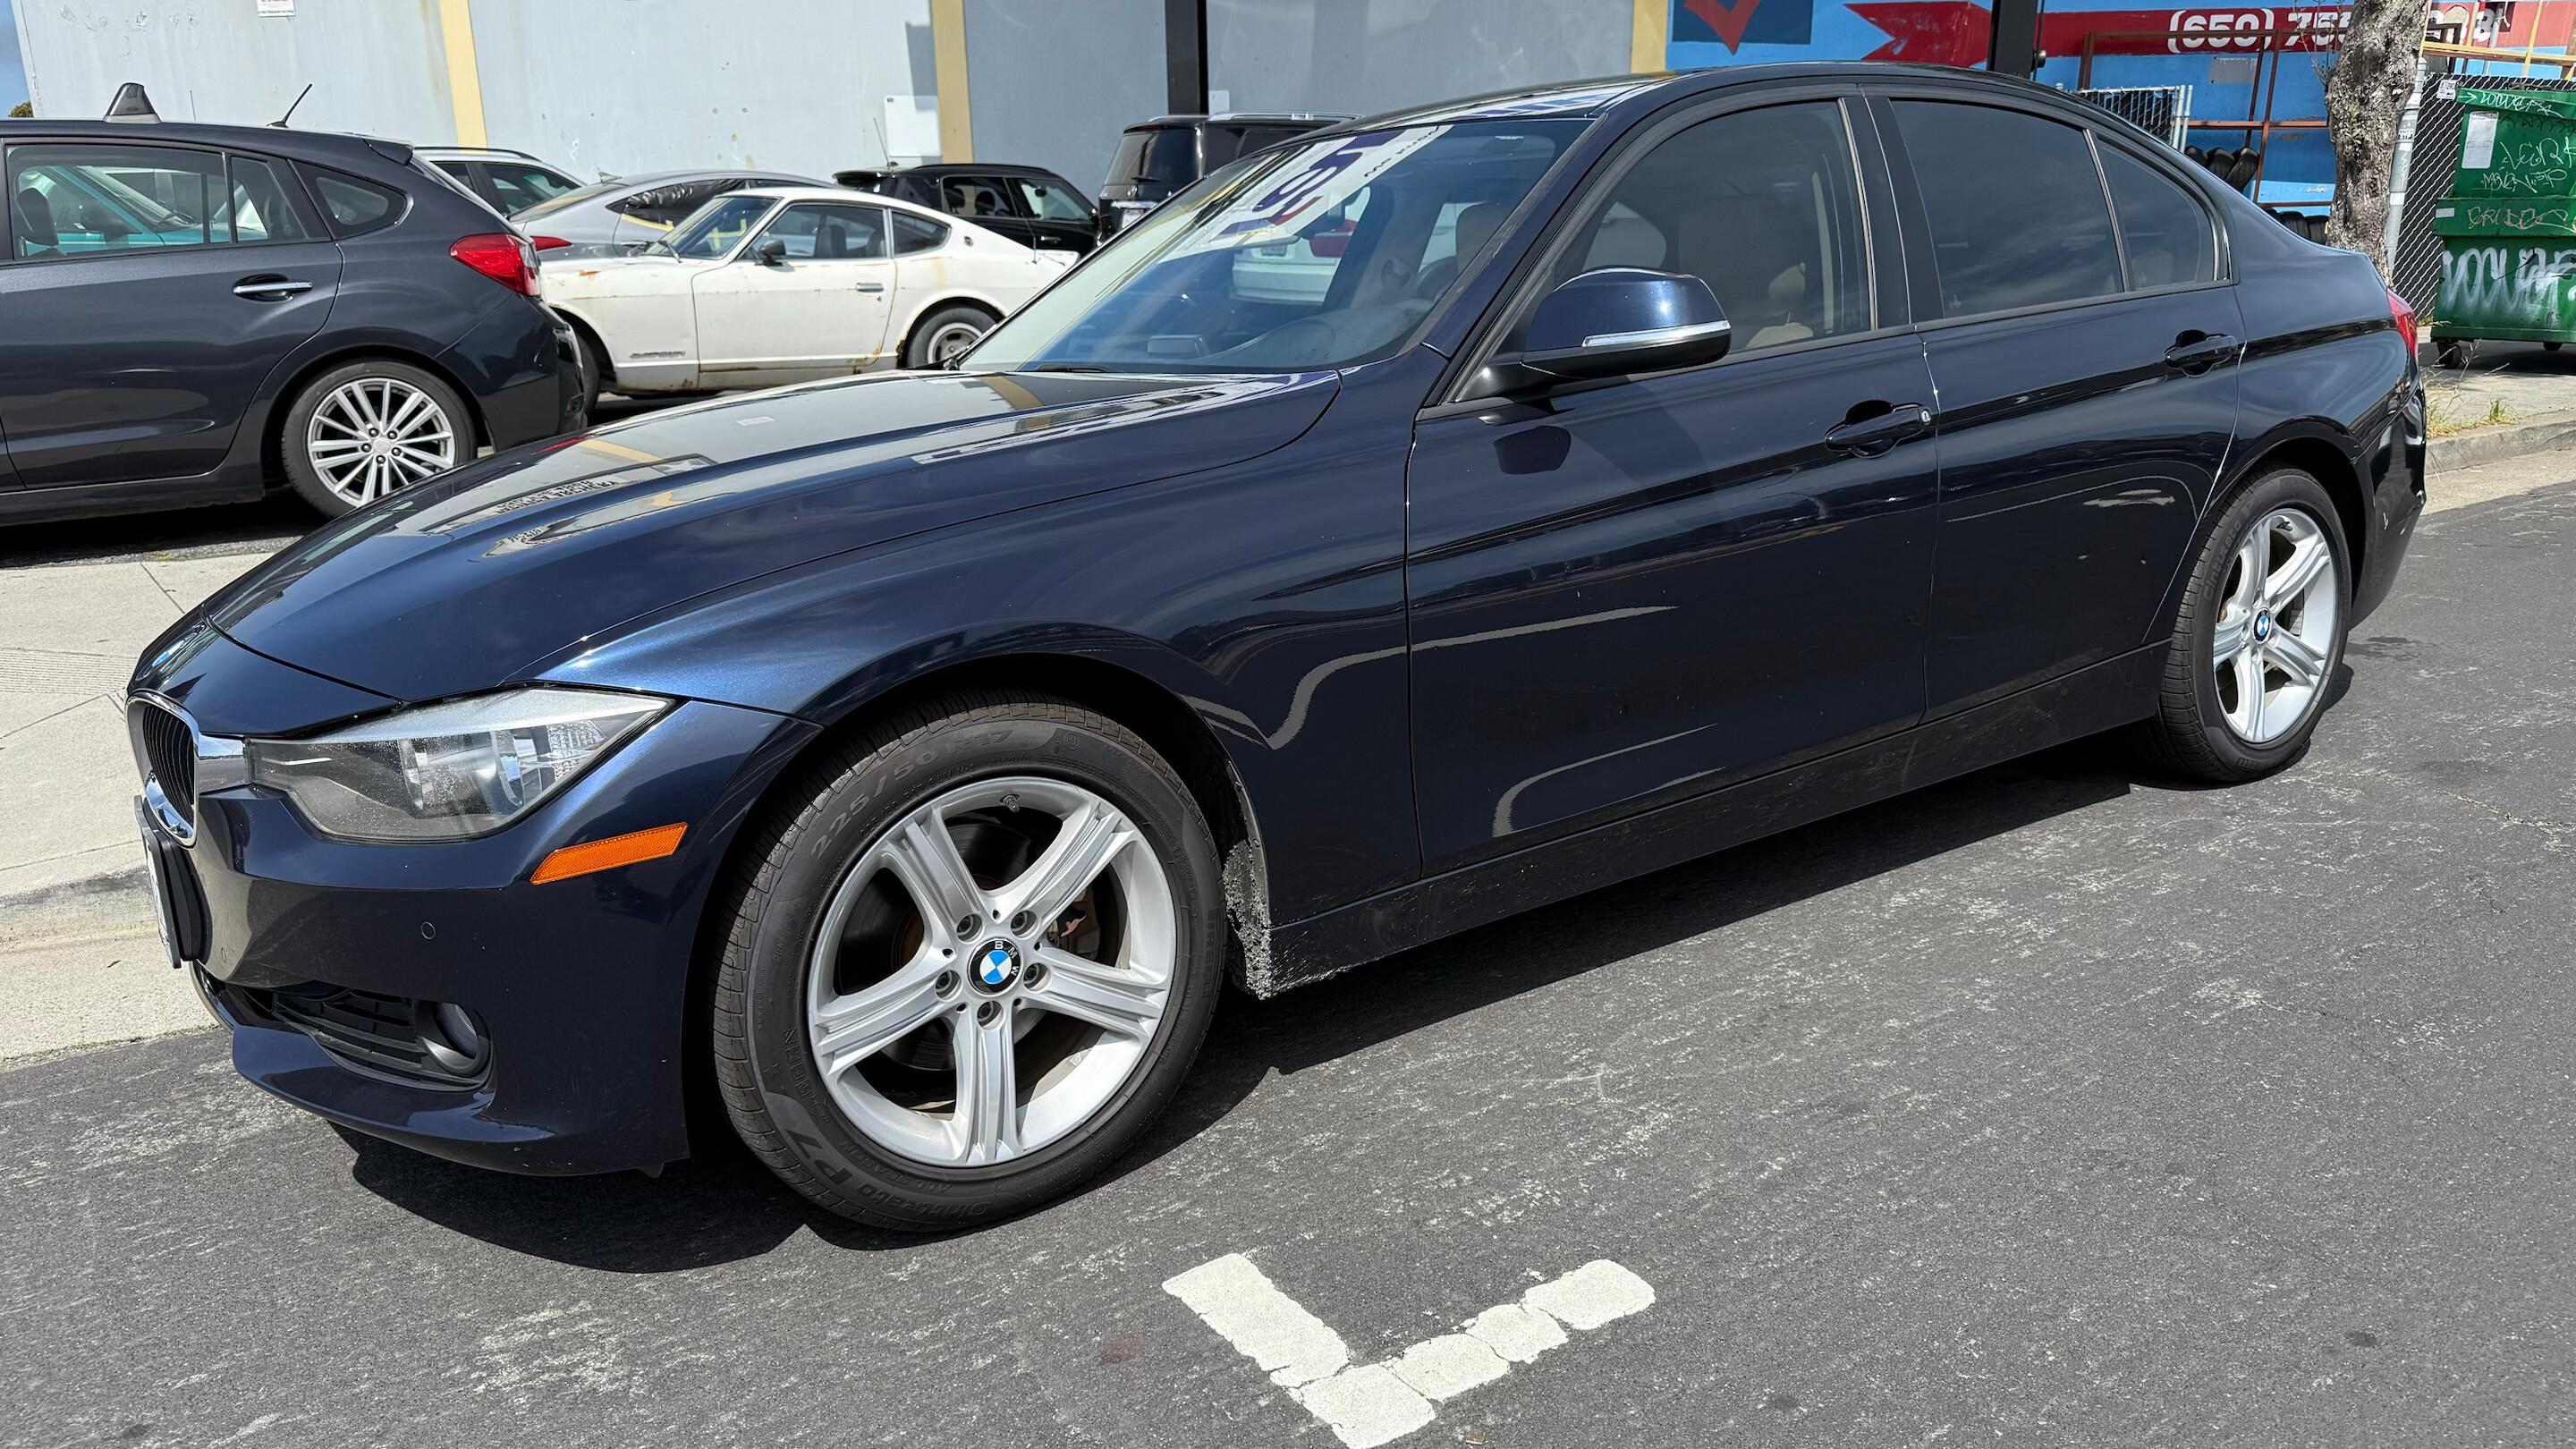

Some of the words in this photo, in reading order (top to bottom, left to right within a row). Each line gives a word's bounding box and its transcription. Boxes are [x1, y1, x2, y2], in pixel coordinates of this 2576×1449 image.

[2167, 8, 2275, 54] (650)
[810, 750, 939, 860] 225/50
[994, 940, 1020, 977] BMW
[785, 1128, 853, 1186] P7
